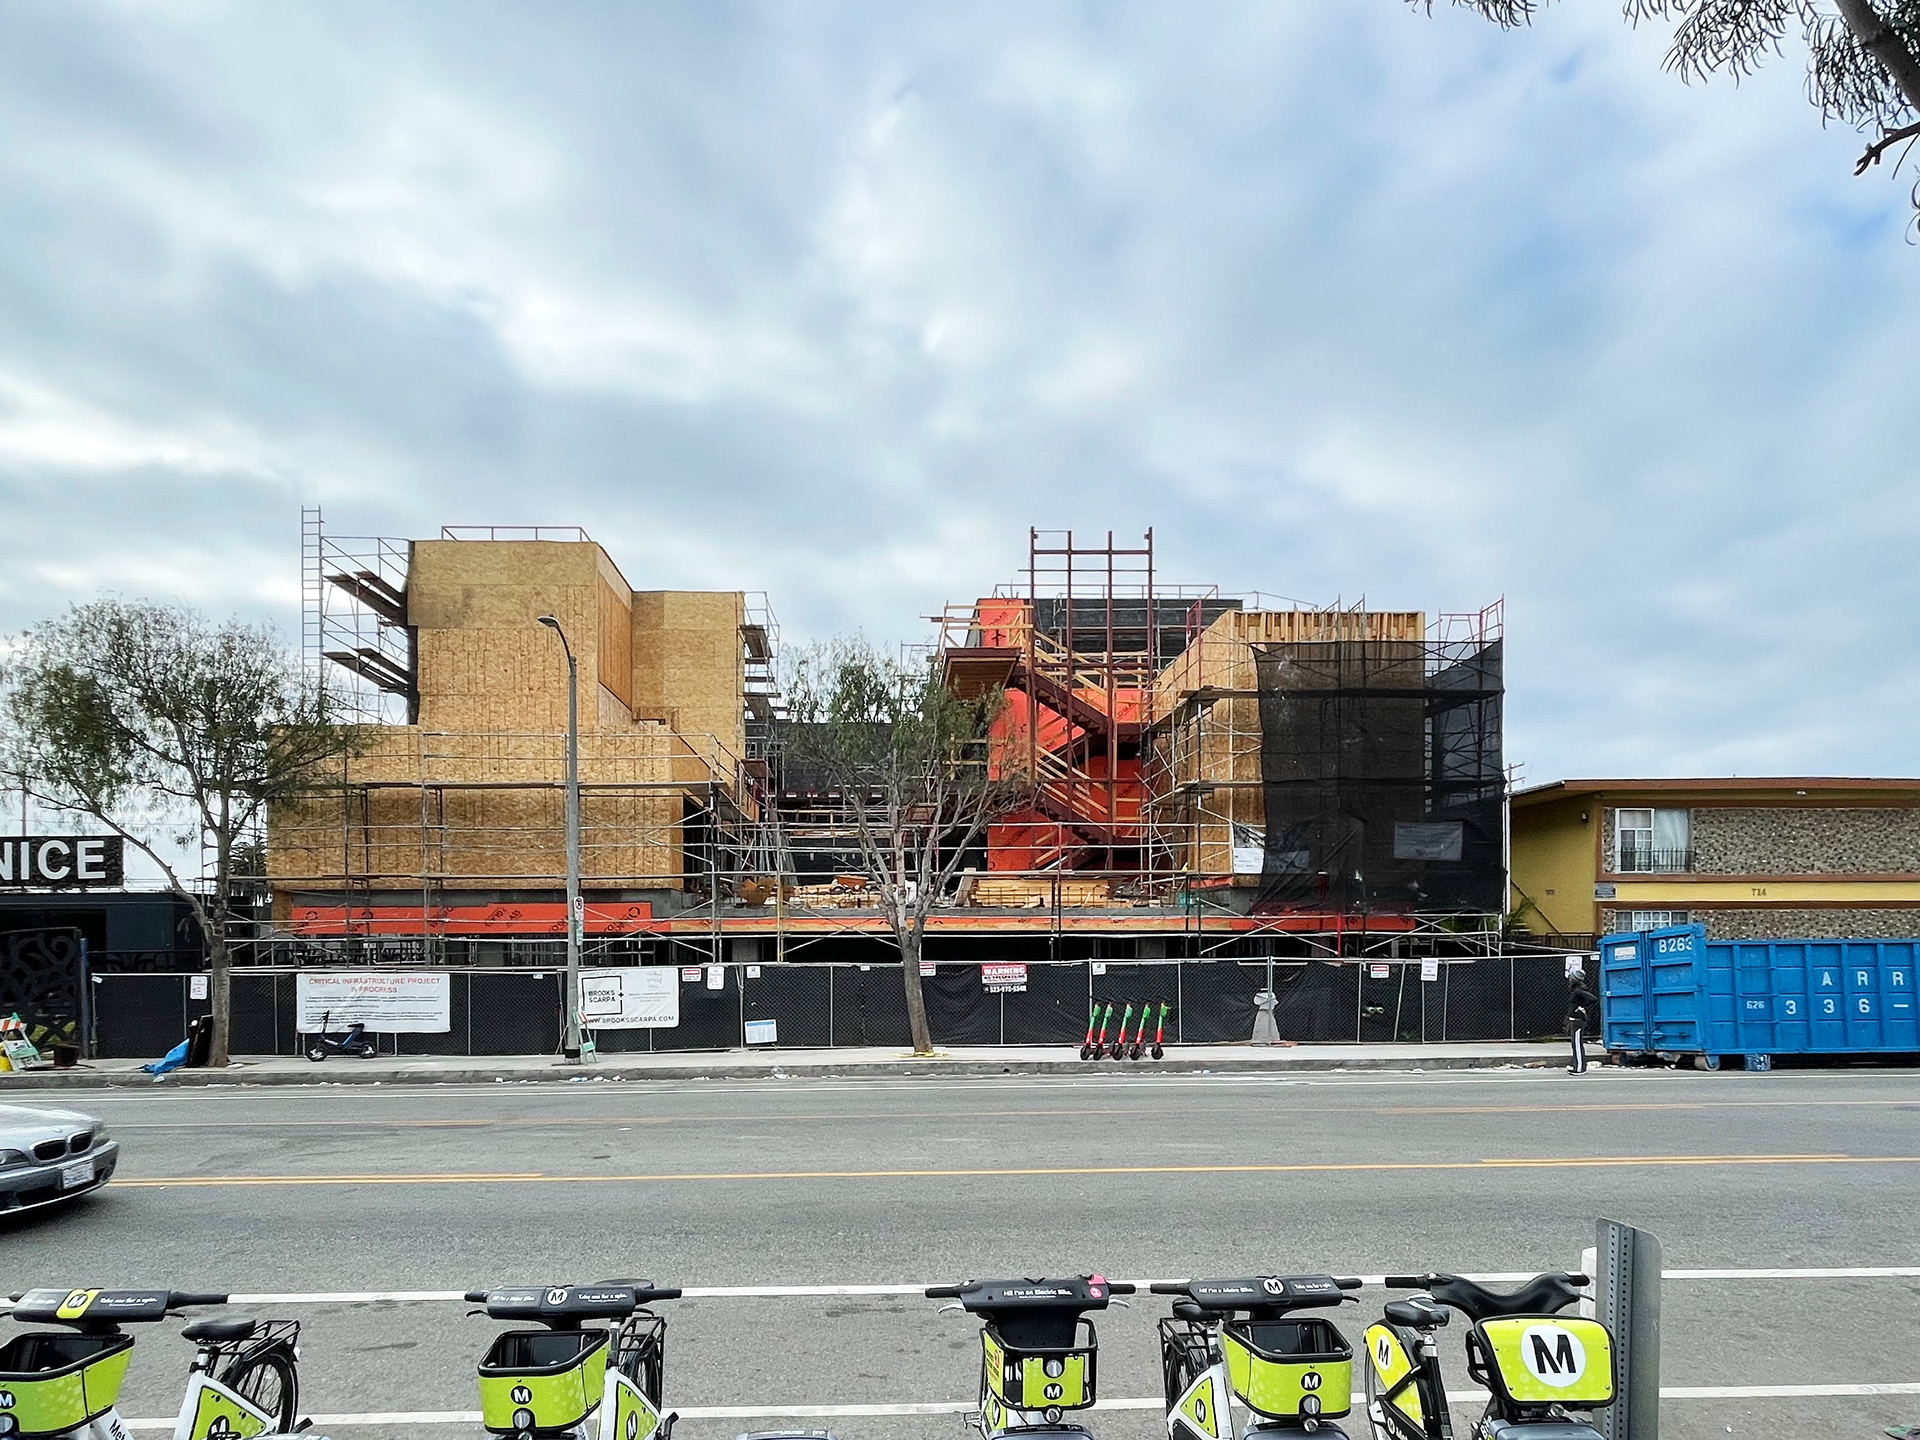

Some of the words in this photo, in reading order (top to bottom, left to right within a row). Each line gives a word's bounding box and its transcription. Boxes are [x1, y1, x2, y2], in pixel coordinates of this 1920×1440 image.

[342, 977, 405, 985] INFRASTRUCTURE
[1267, 1281, 1281, 1291] M
[70, 1295, 87, 1308] M
[1378, 1339, 1389, 1366] M
[1529, 1334, 1577, 1374] M
[1303, 1375, 1319, 1389] M
[513, 1388, 530, 1402] M
[1046, 1385, 1061, 1398] M
[0, 1393, 13, 1406] M
